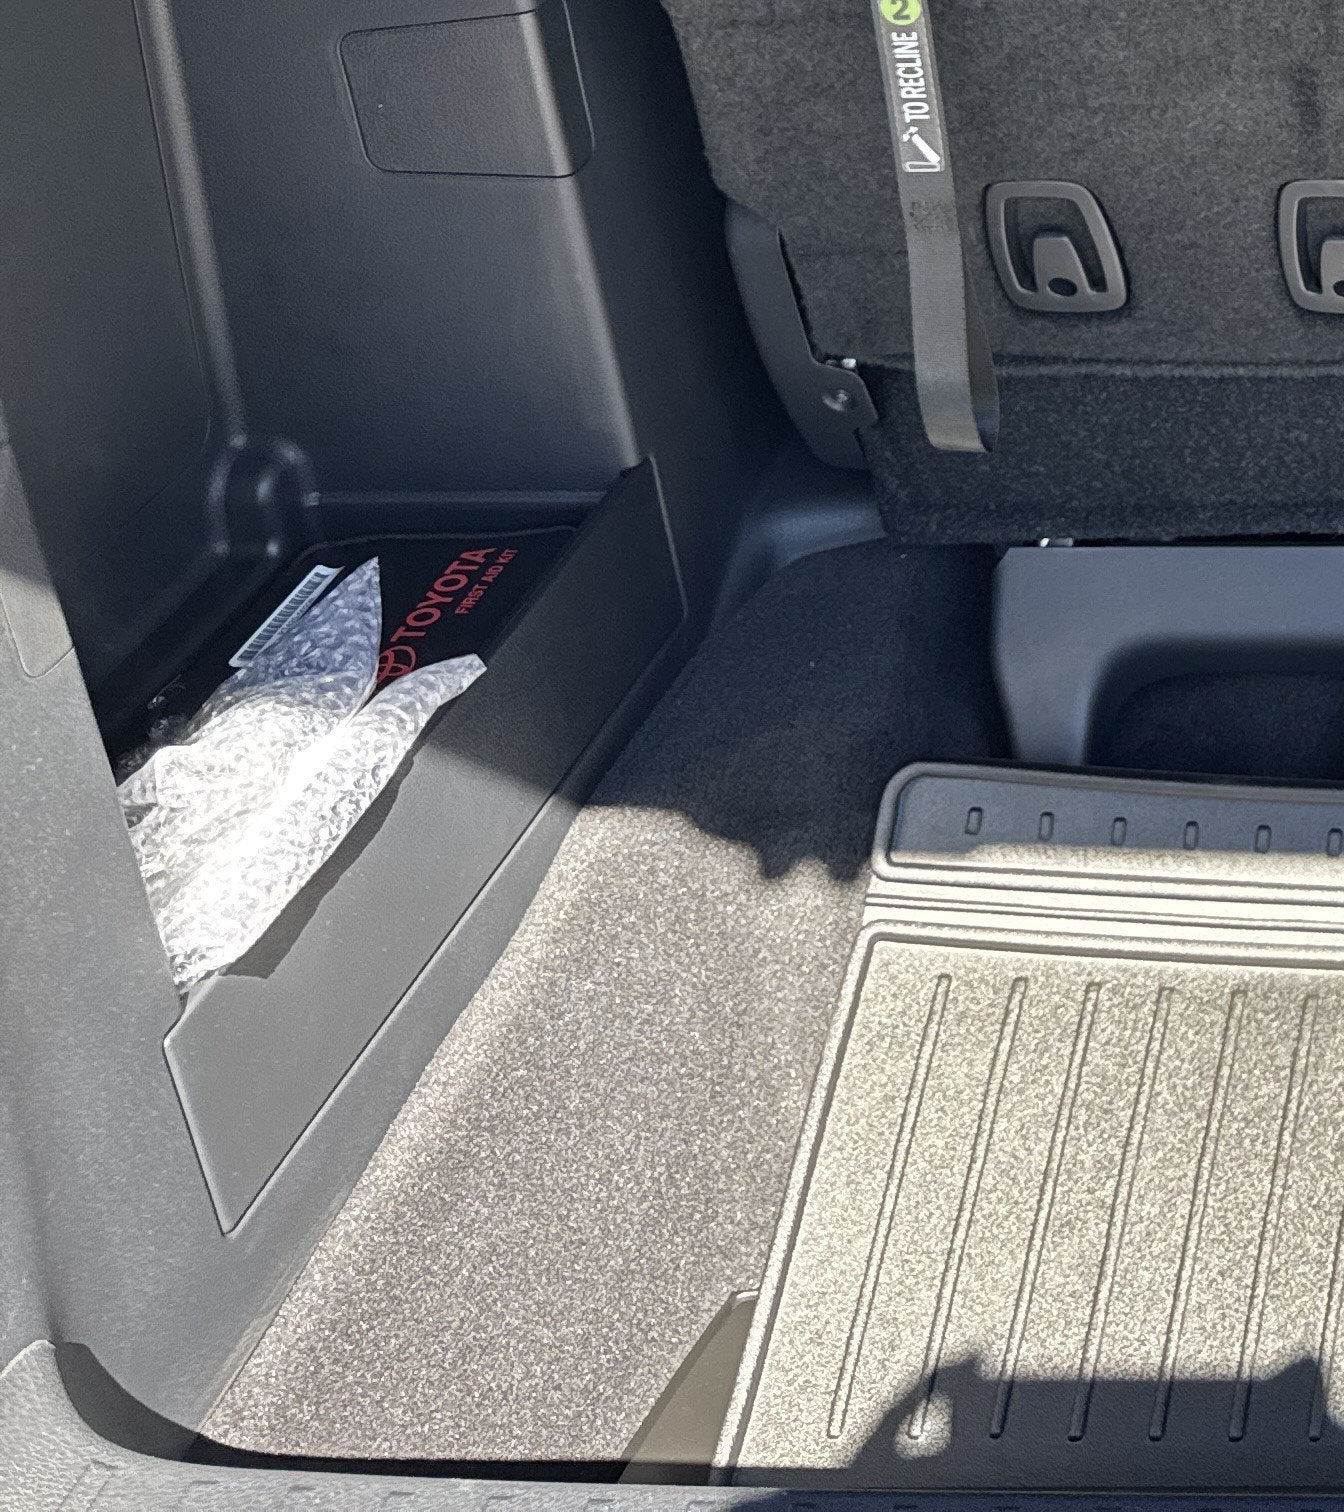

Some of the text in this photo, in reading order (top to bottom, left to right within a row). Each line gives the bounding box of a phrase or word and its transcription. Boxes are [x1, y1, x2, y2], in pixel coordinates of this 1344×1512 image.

[891, 31, 930, 123] TO RECLINE
[390, 547, 498, 643] TOYOTA
[454, 584, 489, 614] FIRST
[481, 564, 505, 583] AID
